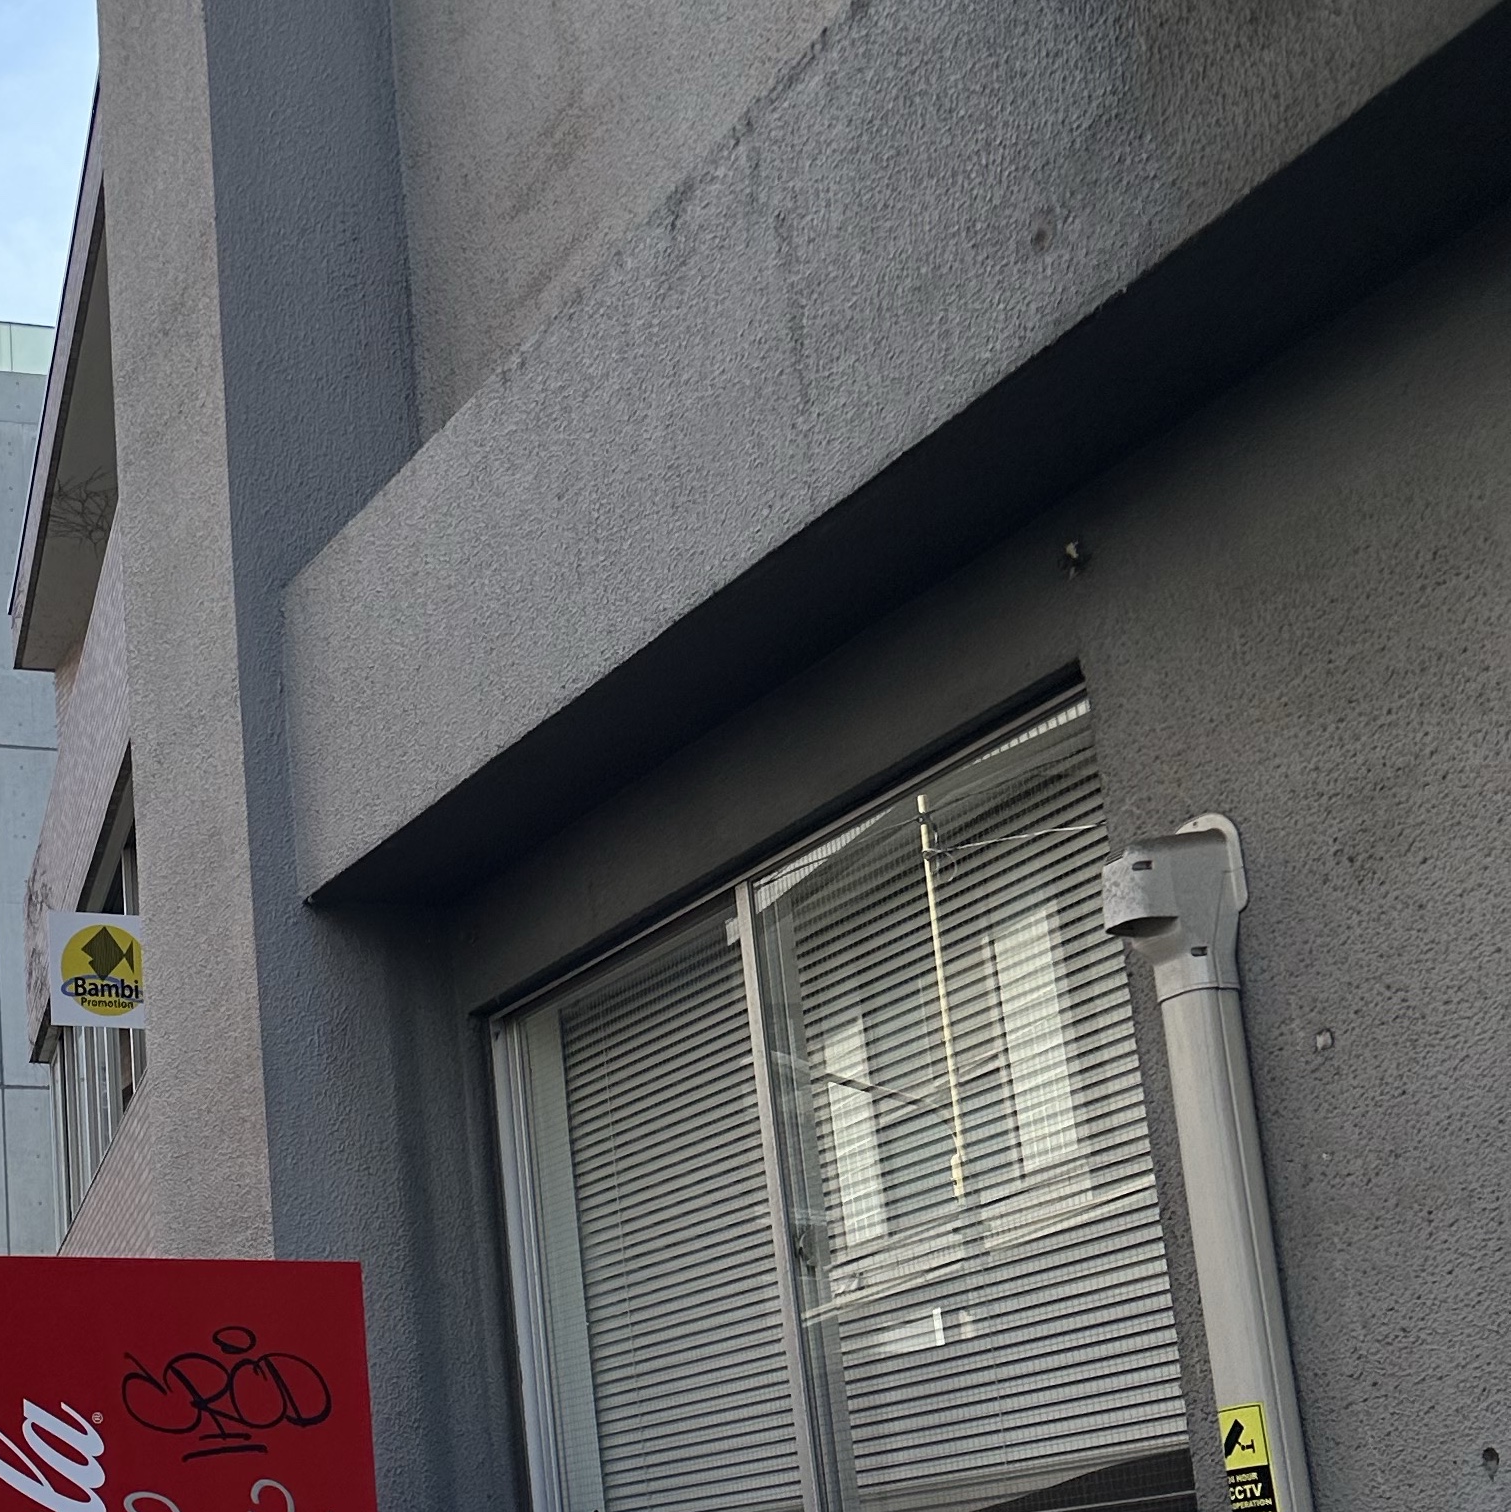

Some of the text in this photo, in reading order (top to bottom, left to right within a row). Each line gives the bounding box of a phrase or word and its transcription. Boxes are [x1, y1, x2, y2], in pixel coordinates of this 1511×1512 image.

[74, 977, 138, 999] Bambi
[81, 997, 134, 1009] Promotion
[1229, 1483, 1262, 1500] CCTV
